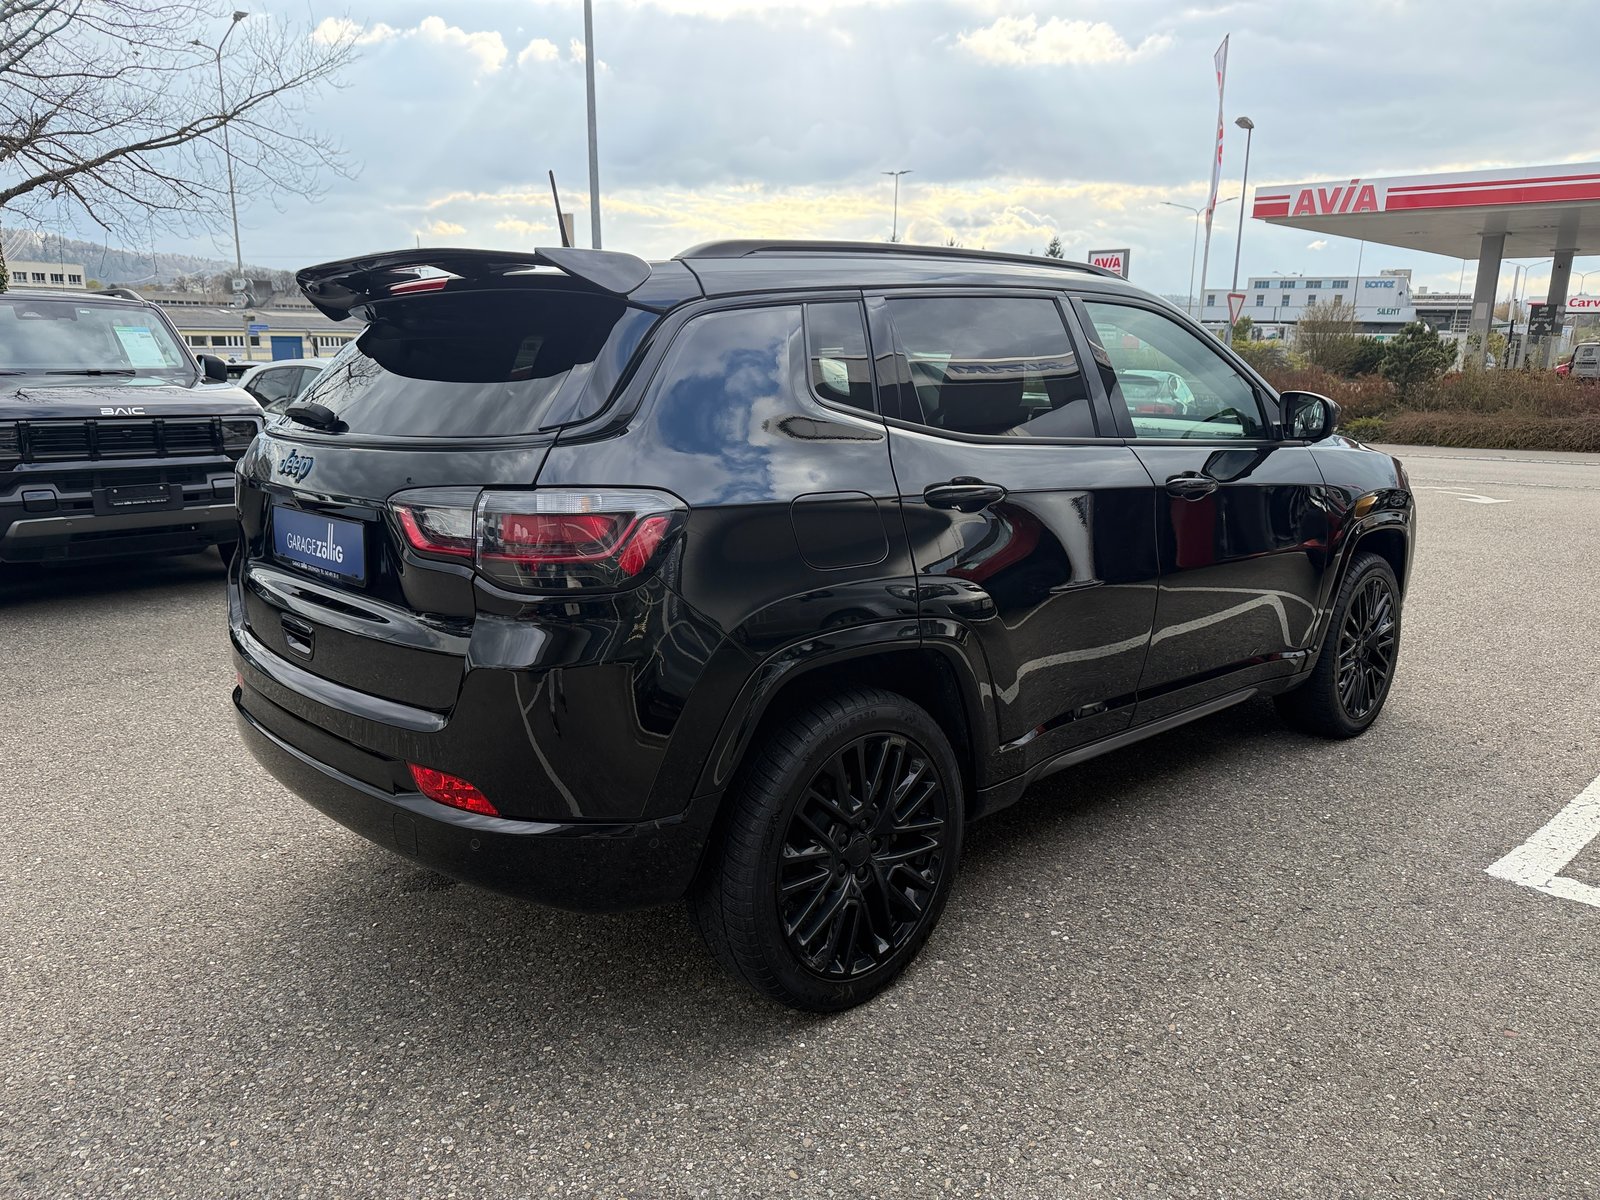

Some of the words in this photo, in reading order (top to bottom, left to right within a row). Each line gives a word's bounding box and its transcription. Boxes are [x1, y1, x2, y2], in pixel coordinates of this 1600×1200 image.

[1292, 179, 1379, 215] AVIA
[1094, 255, 1121, 268] AVIA
[100, 407, 146, 415] BAIC
[278, 448, 315, 483] Jeep
